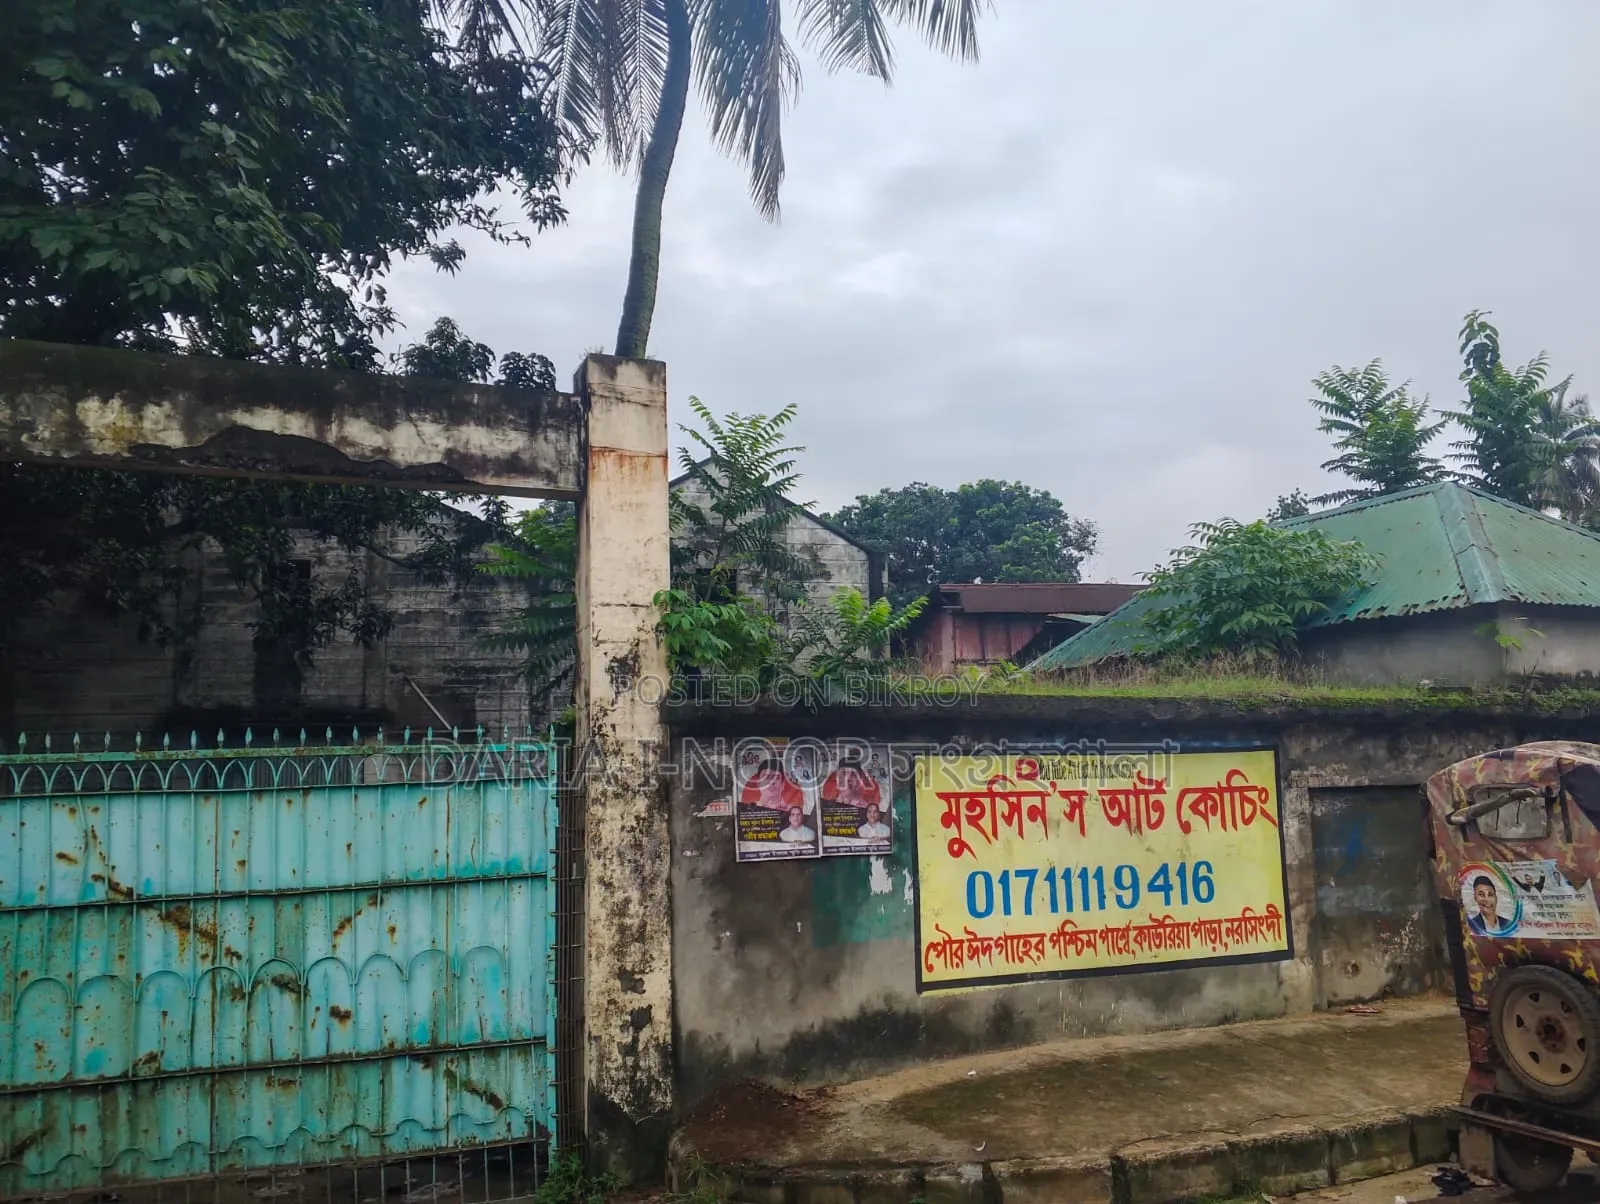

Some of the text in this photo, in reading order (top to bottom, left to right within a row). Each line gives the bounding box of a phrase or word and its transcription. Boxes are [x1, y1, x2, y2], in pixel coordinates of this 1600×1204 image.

[1176, 768, 1278, 835] কোচিং
[966, 860, 1215, 919] 01711119416
[924, 923, 965, 973] পৌর
[1048, 919, 1098, 959] পশ্চিম
